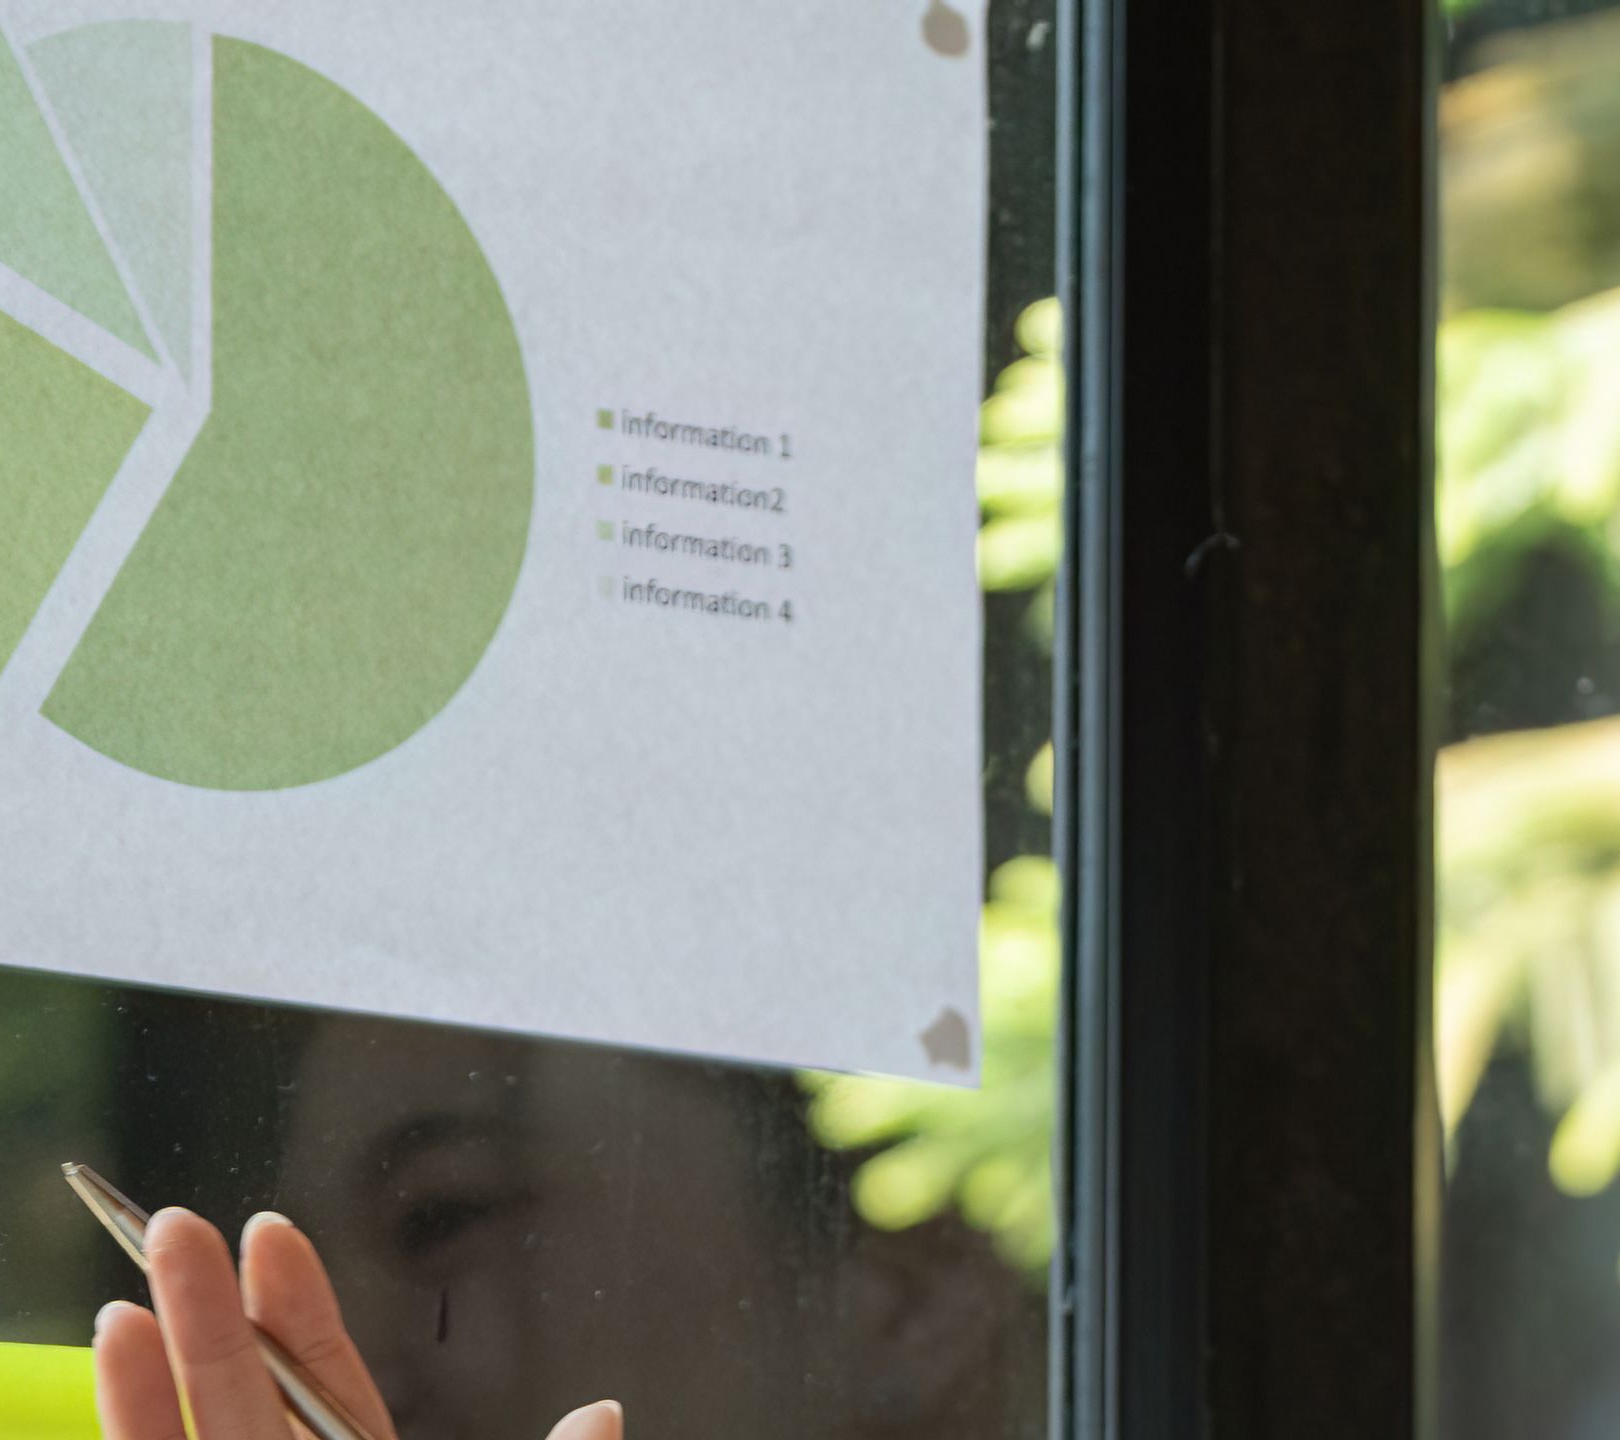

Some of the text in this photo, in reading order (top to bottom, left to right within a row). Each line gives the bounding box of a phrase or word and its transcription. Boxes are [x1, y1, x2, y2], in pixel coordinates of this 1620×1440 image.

[620, 409, 793, 458] information 1
[621, 520, 793, 568] information 3
[622, 576, 794, 622] information 4
